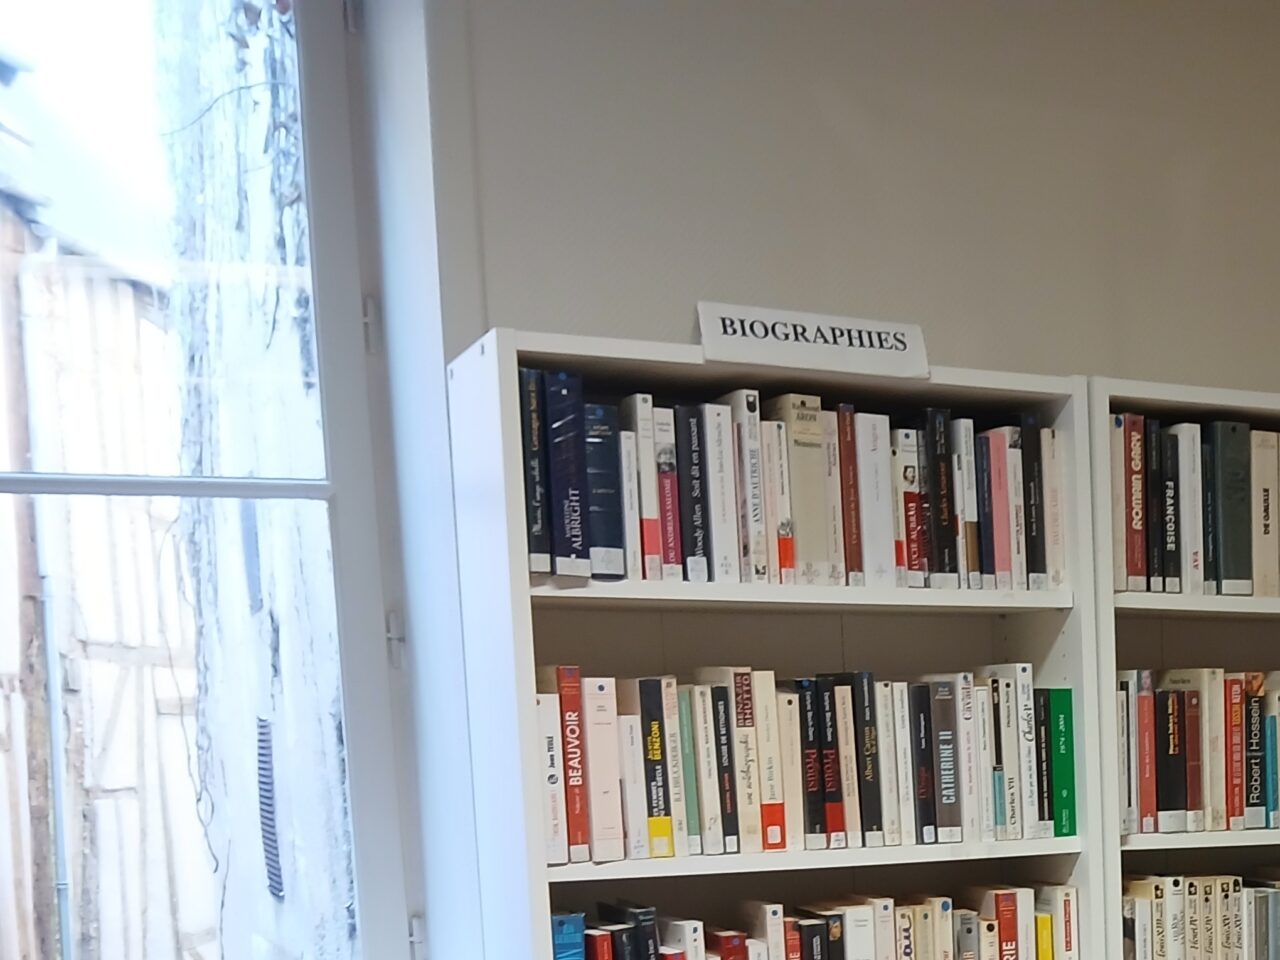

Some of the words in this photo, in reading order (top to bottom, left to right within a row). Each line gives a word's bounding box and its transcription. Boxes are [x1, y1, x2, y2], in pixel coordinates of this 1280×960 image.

[720, 316, 907, 352] BIOGRAPHIES
[689, 418, 699, 450] passant
[1131, 431, 1142, 471] GARY
[690, 465, 700, 477] dit
[691, 452, 699, 463] en
[690, 480, 701, 497] Soit
[1131, 475, 1142, 530] ROMAIN
[569, 488, 582, 549] ALBRIGHT
[693, 504, 703, 526] Allen
[1166, 481, 1176, 550] FRANÇOISE
[1263, 523, 1270, 535] DE
[910, 542, 919, 569] LUCIE
[1192, 551, 1200, 570] AVA
[736, 675, 745, 726] BENAZIR
[743, 675, 753, 726] BHUTTO
[652, 721, 661, 760] BENZONI
[939, 731, 952, 739] II
[1249, 697, 1260, 750] Hossein
[546, 736, 554, 752] TEULÉ
[565, 711, 583, 785] BEAUVOIR
[864, 757, 874, 781] Albert
[939, 744, 956, 804] CATHERINE
[1249, 759, 1260, 803] Robert
[1008, 792, 1016, 825] Charles
